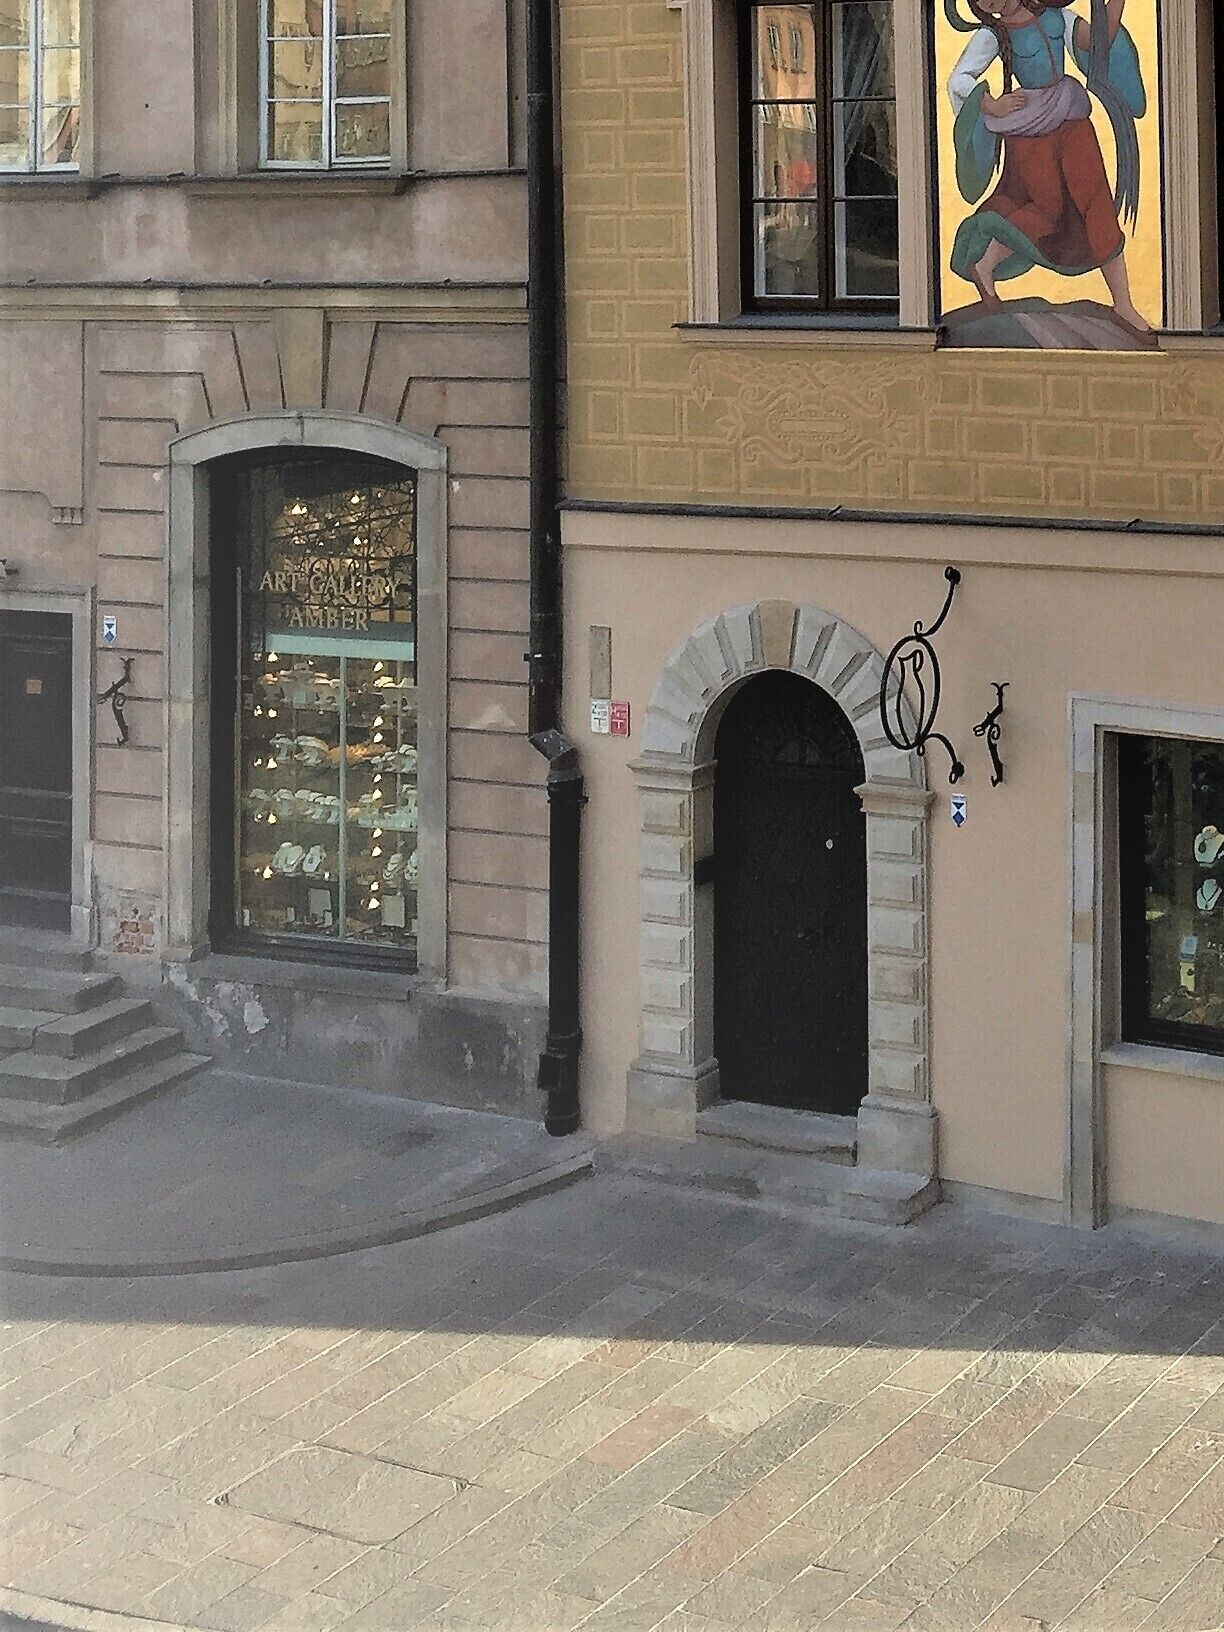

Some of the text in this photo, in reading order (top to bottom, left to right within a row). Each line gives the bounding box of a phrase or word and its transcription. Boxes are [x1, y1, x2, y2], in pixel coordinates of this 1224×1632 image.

[259, 570, 399, 599] ART GALLERY
[289, 606, 369, 631] AMBER
